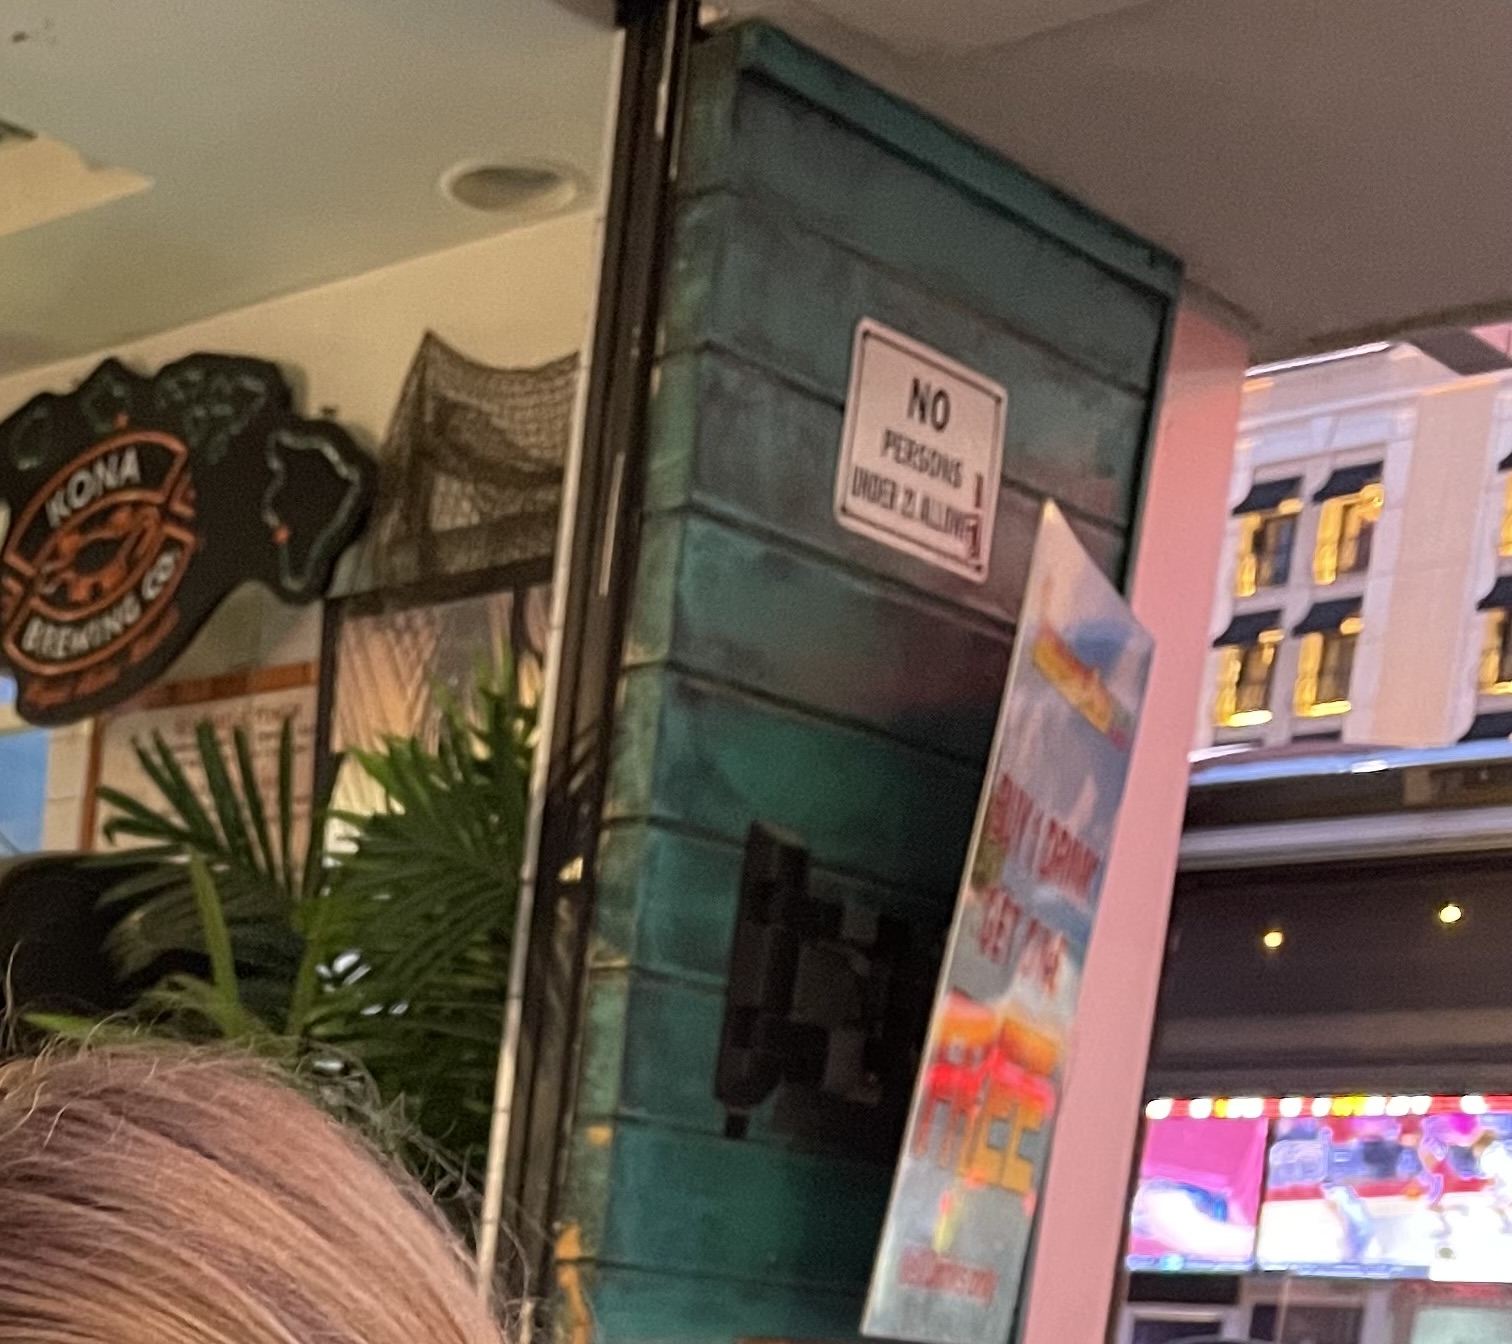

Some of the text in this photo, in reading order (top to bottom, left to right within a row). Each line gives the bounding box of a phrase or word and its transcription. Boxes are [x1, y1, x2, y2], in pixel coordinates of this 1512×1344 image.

[907, 377, 950, 431] NO
[45, 446, 141, 528] KONA
[880, 429, 964, 489] PERSONS
[22, 592, 141, 659] BREWING
